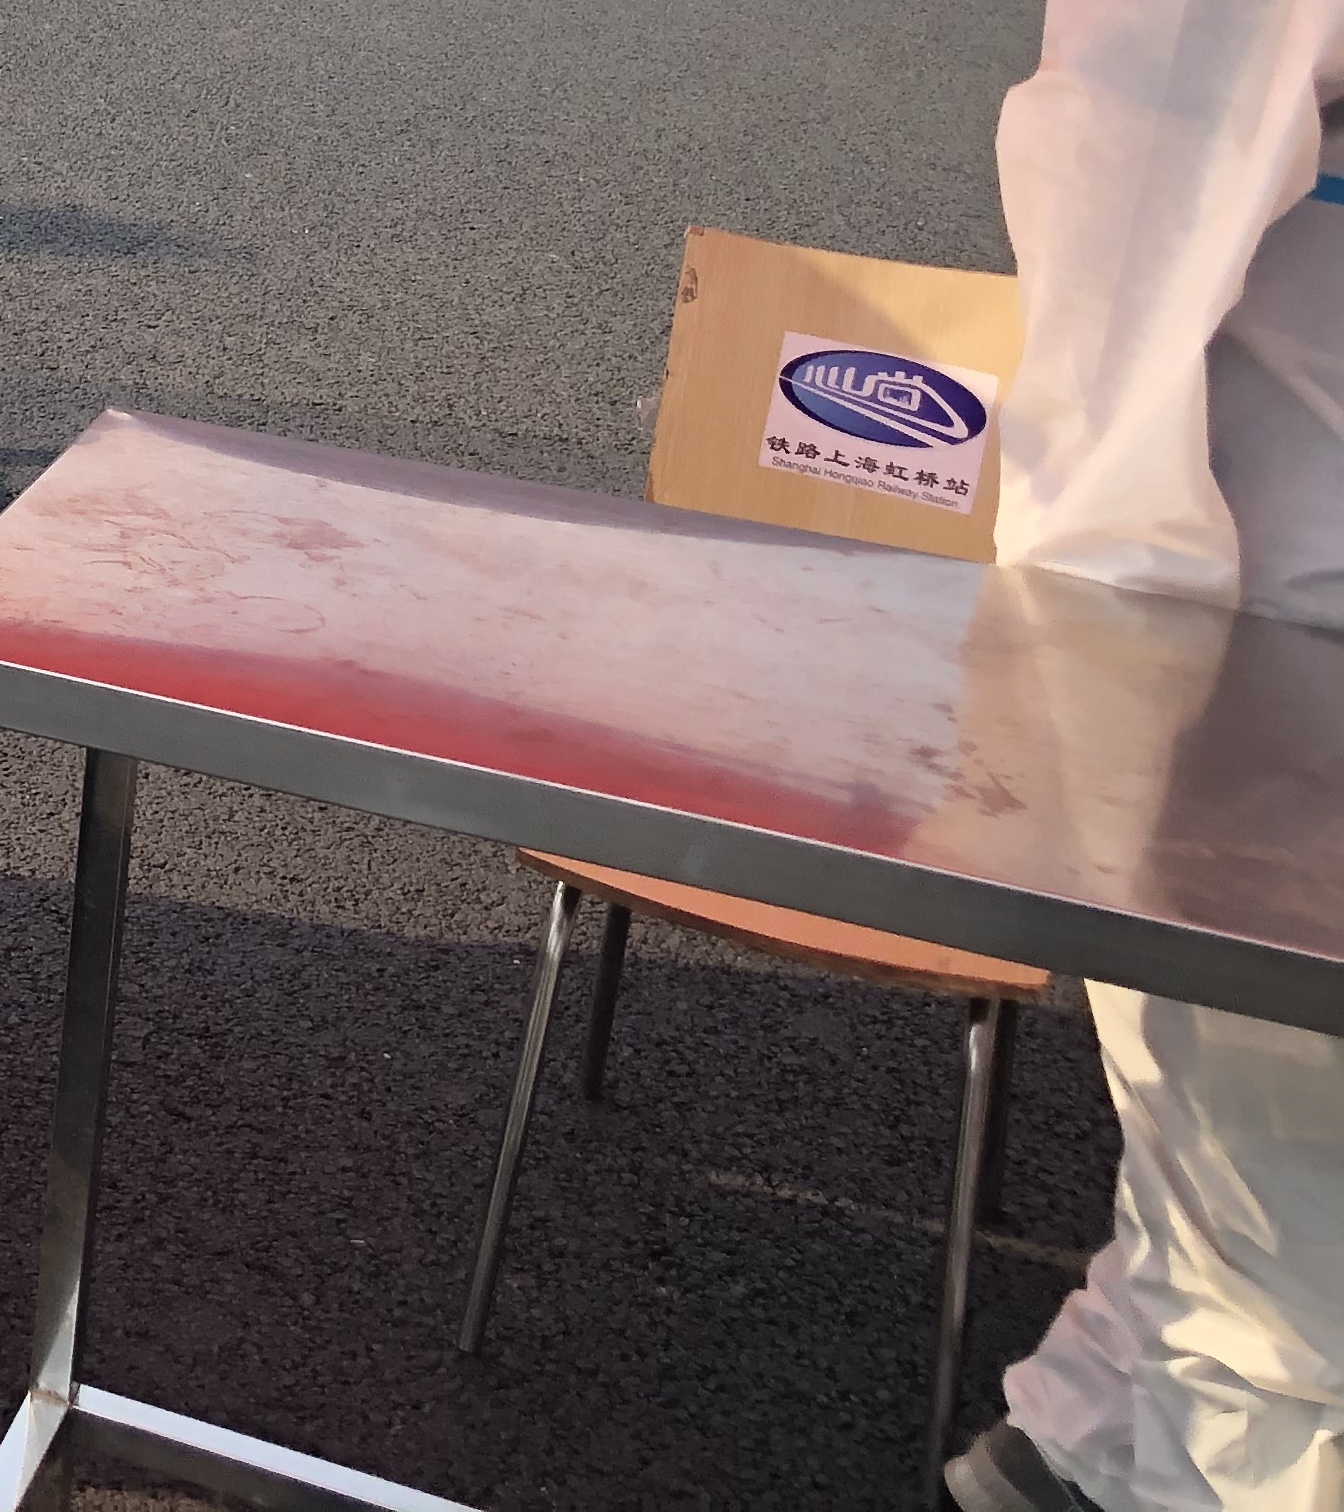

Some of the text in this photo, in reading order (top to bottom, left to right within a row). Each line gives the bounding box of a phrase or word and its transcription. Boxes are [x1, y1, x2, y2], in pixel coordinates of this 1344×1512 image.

[766, 435, 970, 496] 铁路上海虹桥站
[771, 455, 959, 508] Shanghai Hongqiao Railway Station
